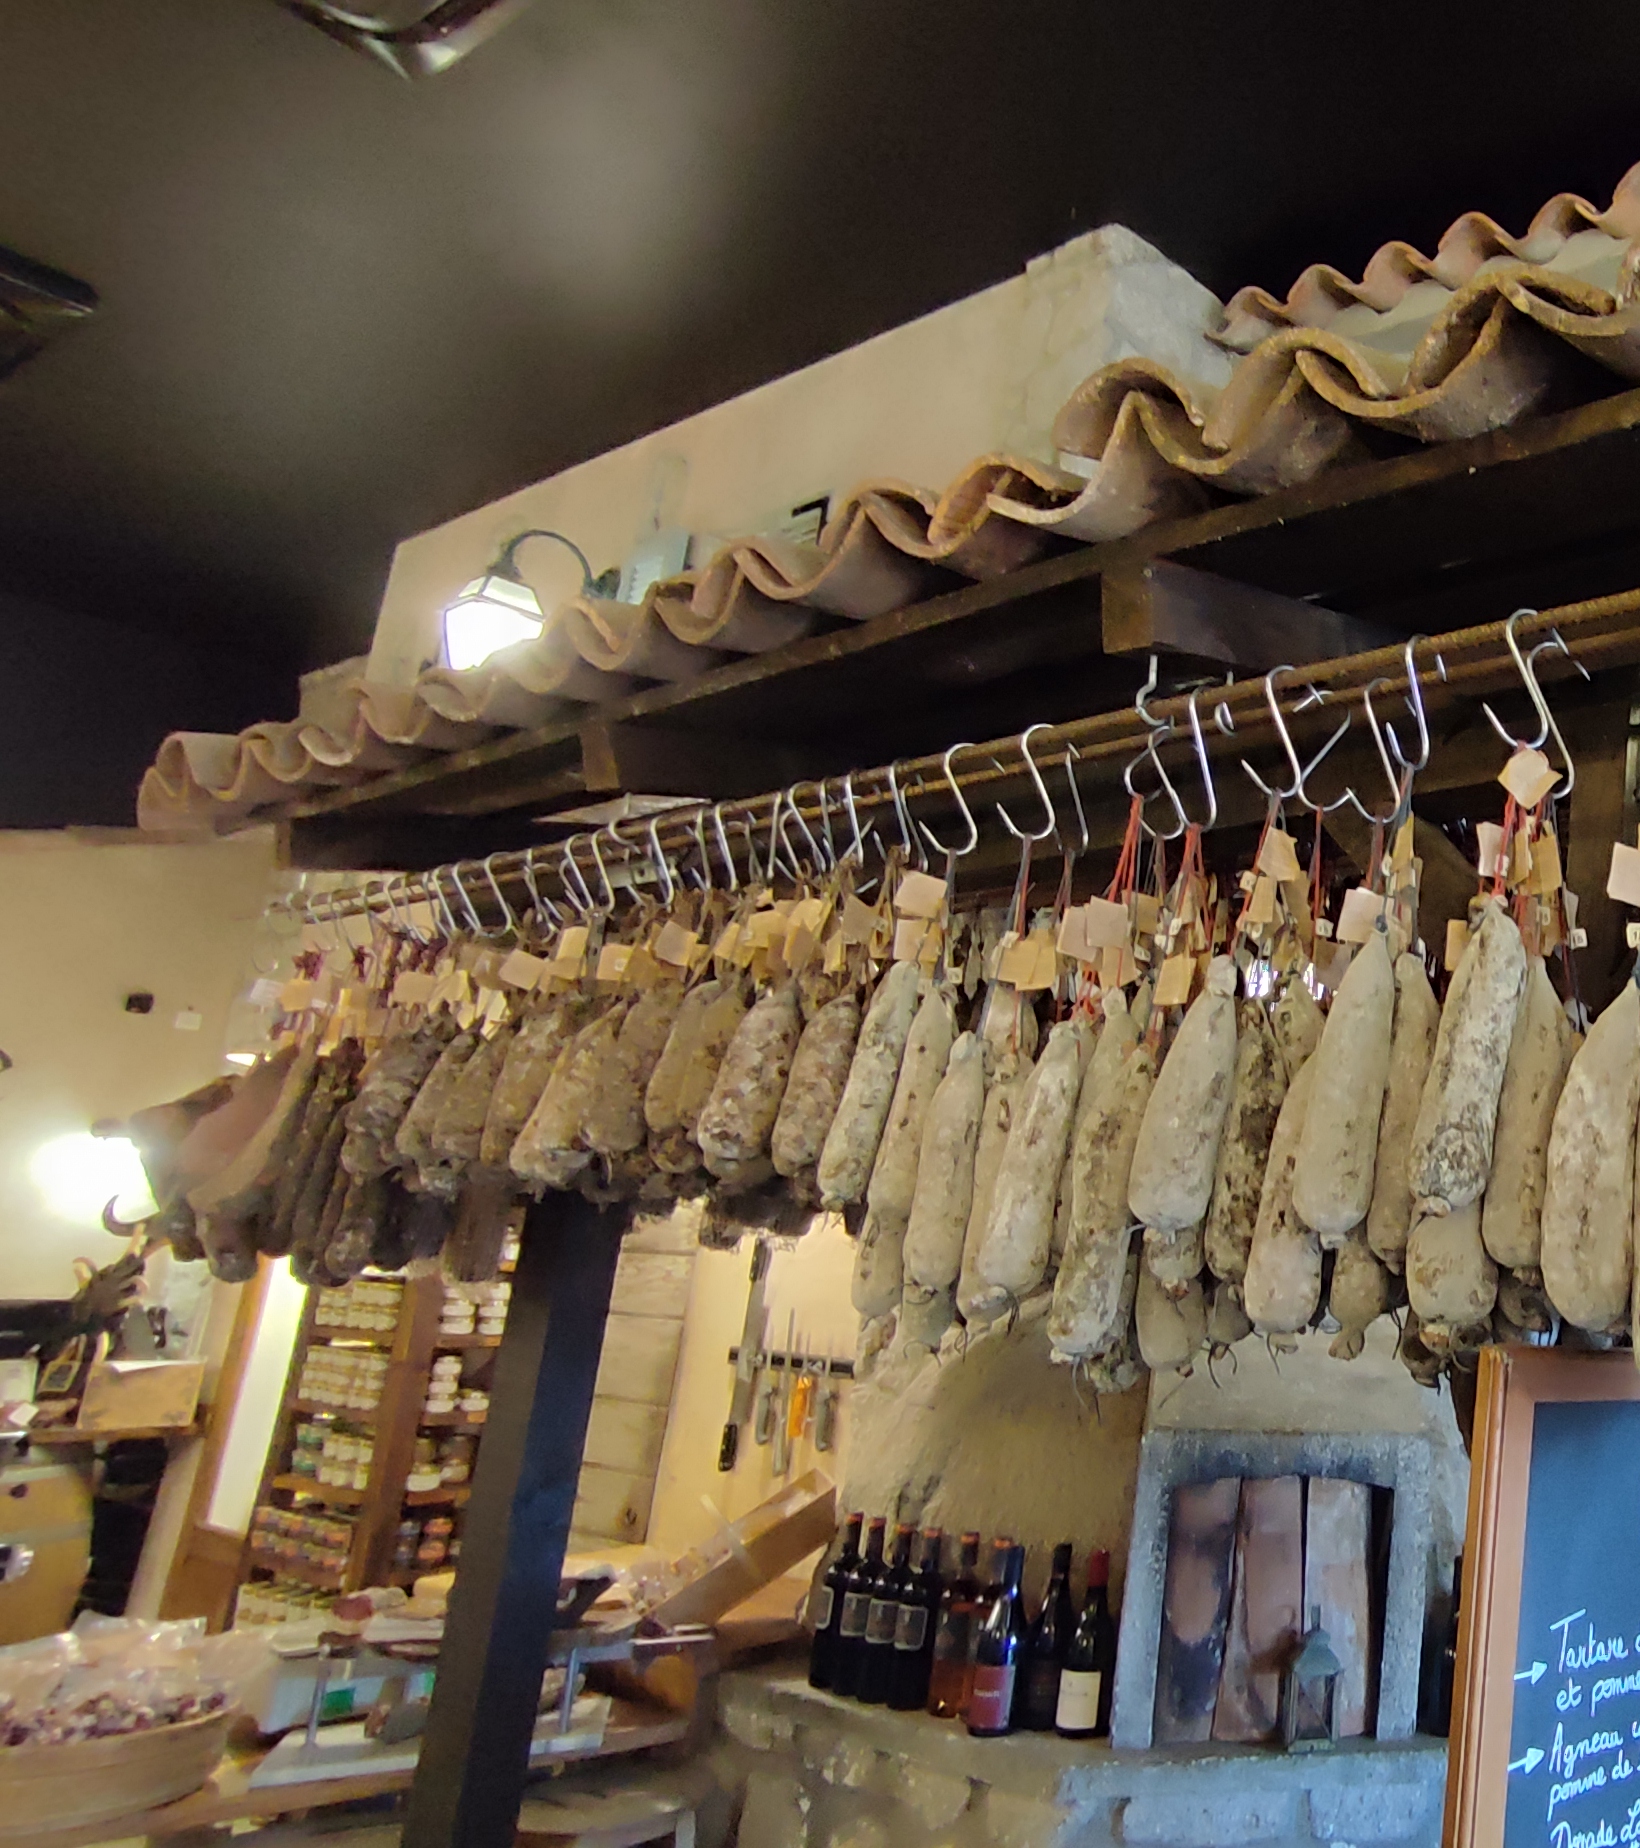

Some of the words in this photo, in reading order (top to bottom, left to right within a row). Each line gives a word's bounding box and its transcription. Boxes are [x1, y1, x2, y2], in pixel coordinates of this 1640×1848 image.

[1550, 1608, 1628, 1673] Tartare
[1555, 1677, 1582, 1712] et
[1549, 1722, 1623, 1779] Agneau
[1547, 1765, 1607, 1823] pomme
[1612, 1749, 1633, 1780] de
